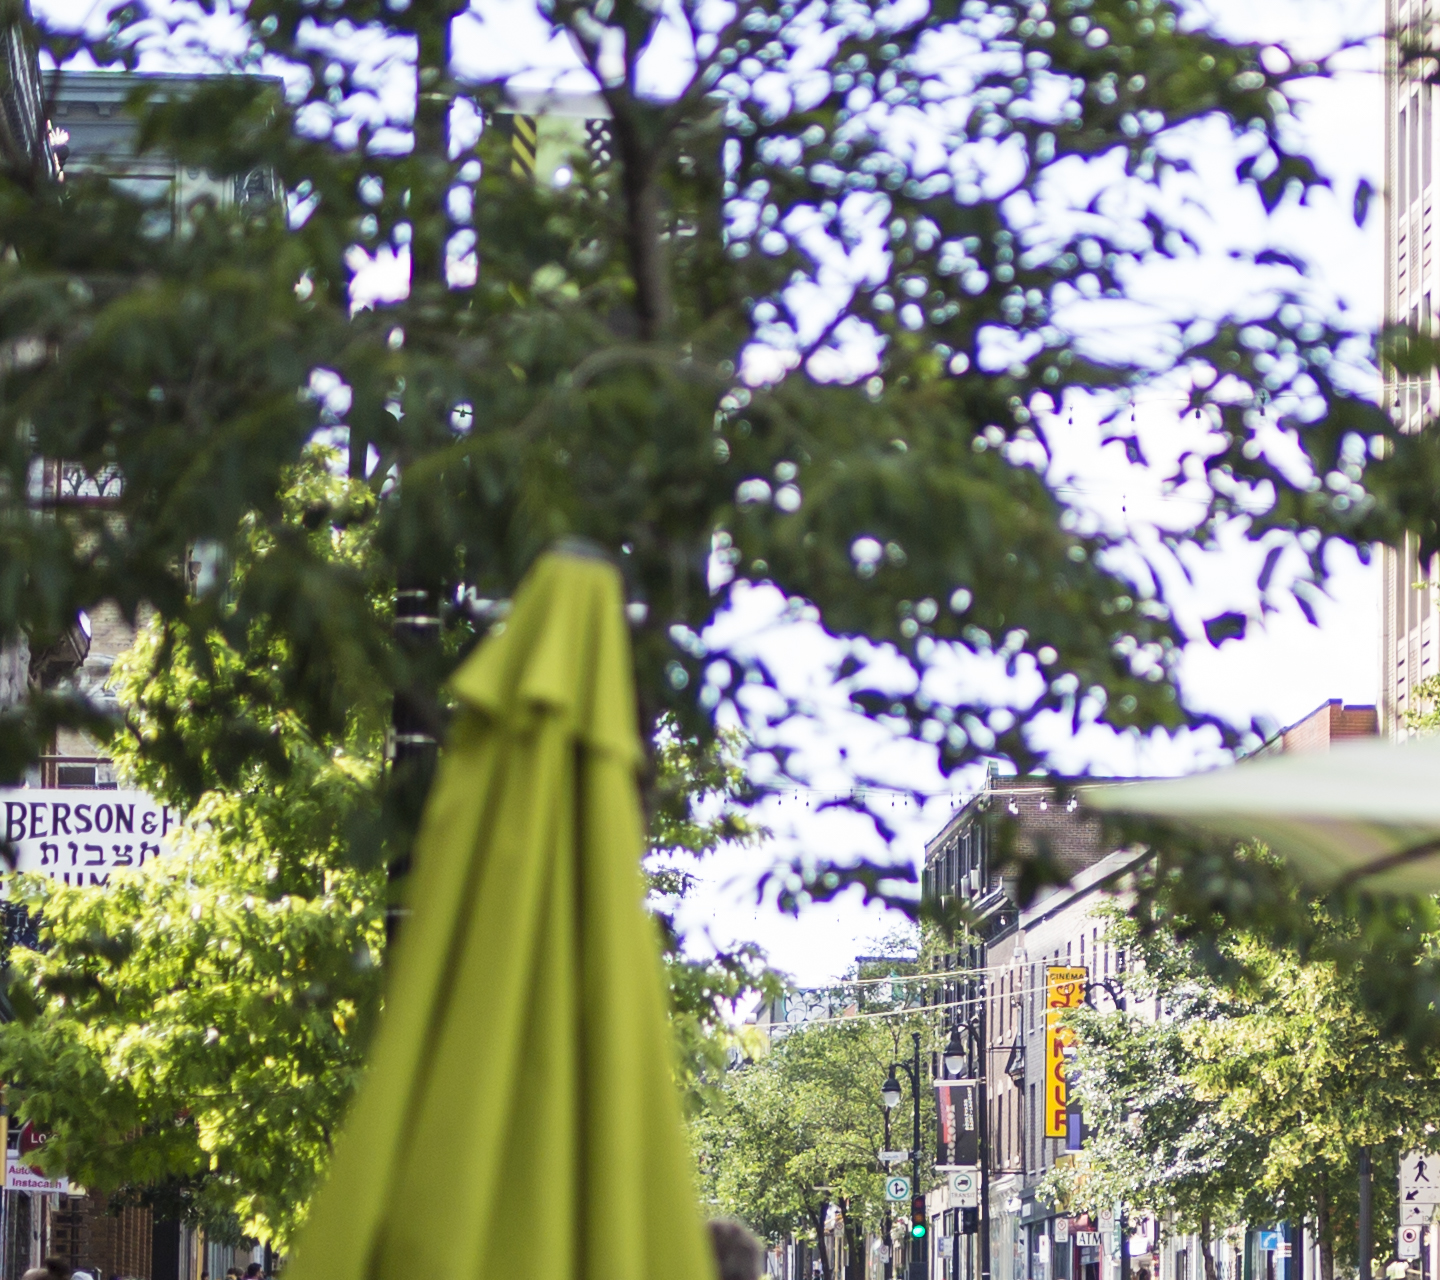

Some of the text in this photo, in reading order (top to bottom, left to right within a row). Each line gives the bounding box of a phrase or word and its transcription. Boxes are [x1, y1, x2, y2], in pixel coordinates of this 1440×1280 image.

[3, 801, 135, 842] BERSON
[140, 811, 158, 834] &
[1079, 1232, 1102, 1245] ATM
